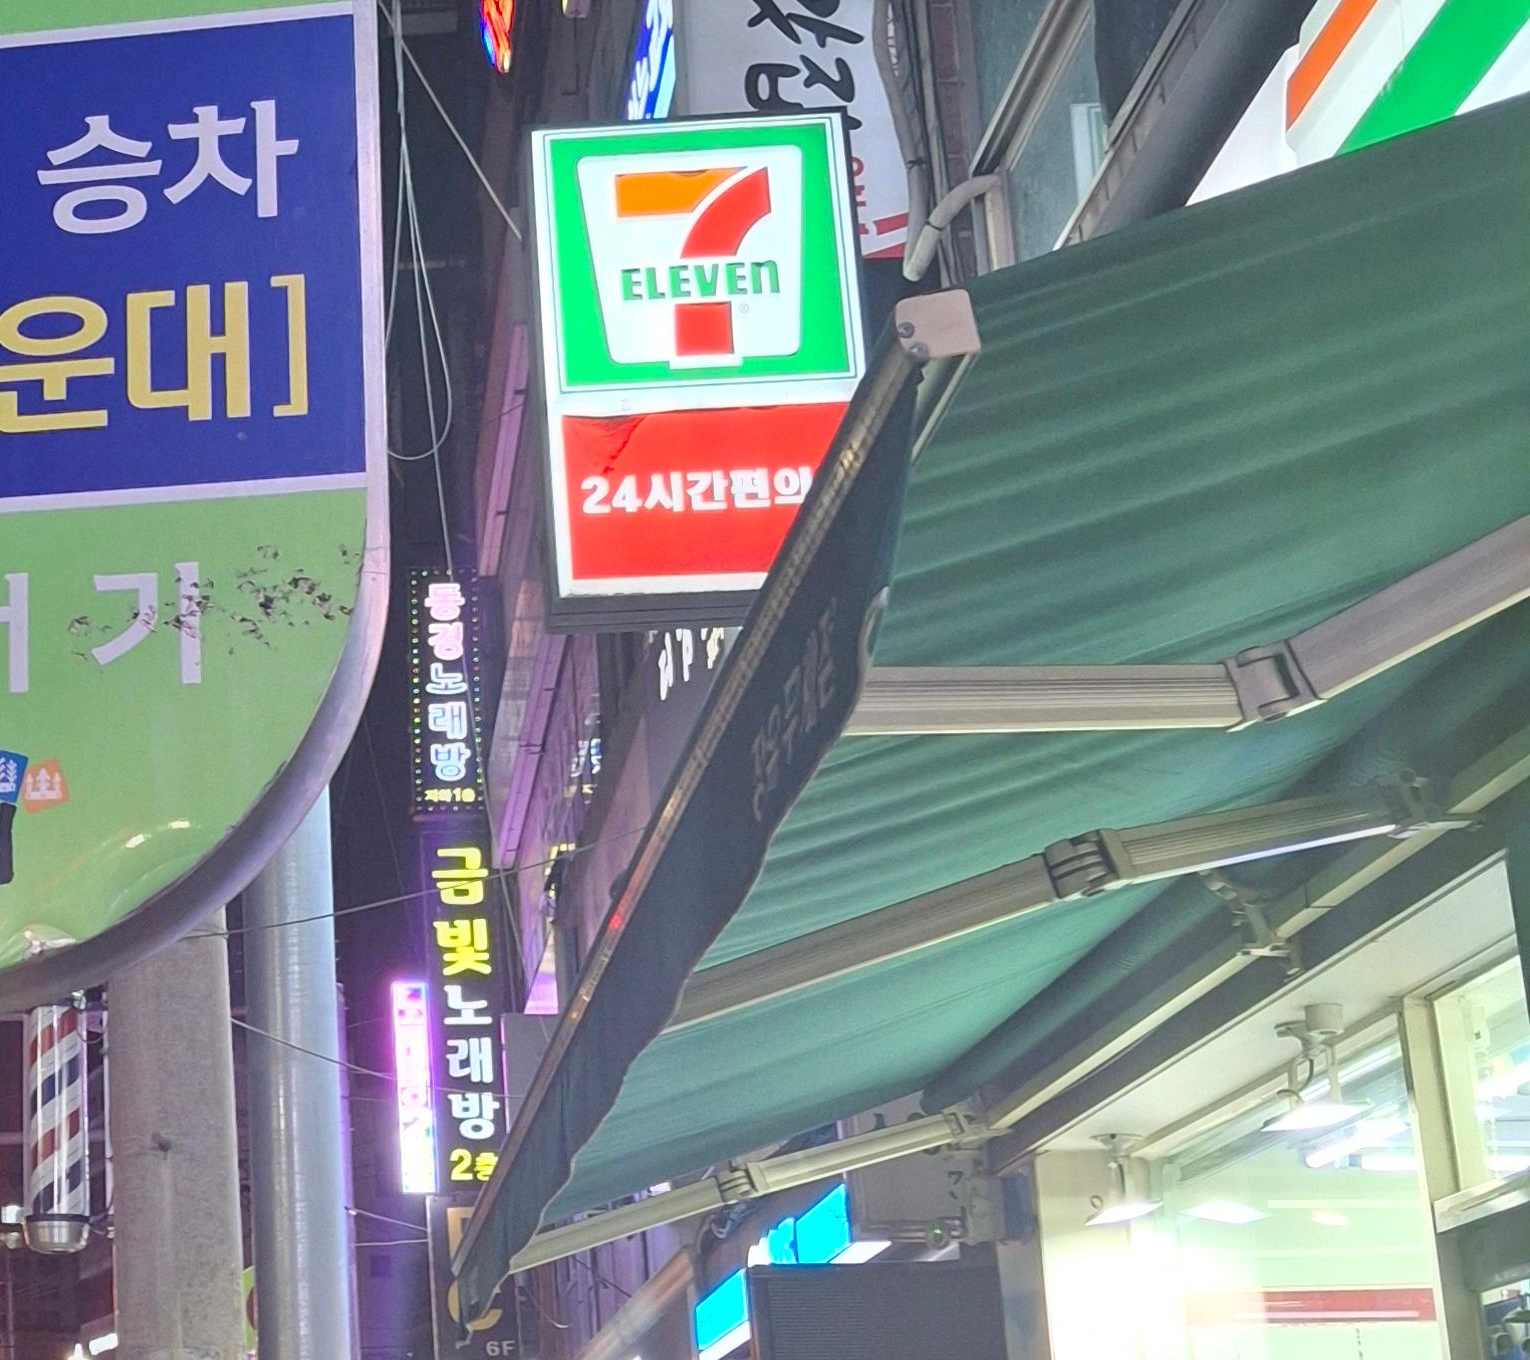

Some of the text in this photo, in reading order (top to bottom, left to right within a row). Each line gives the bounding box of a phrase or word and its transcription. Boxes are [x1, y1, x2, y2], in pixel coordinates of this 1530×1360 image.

[37, 99, 299, 235] 승차
[432, 847, 500, 1139] 금빛노래방
[486, 1340, 516, 1356] 6F
